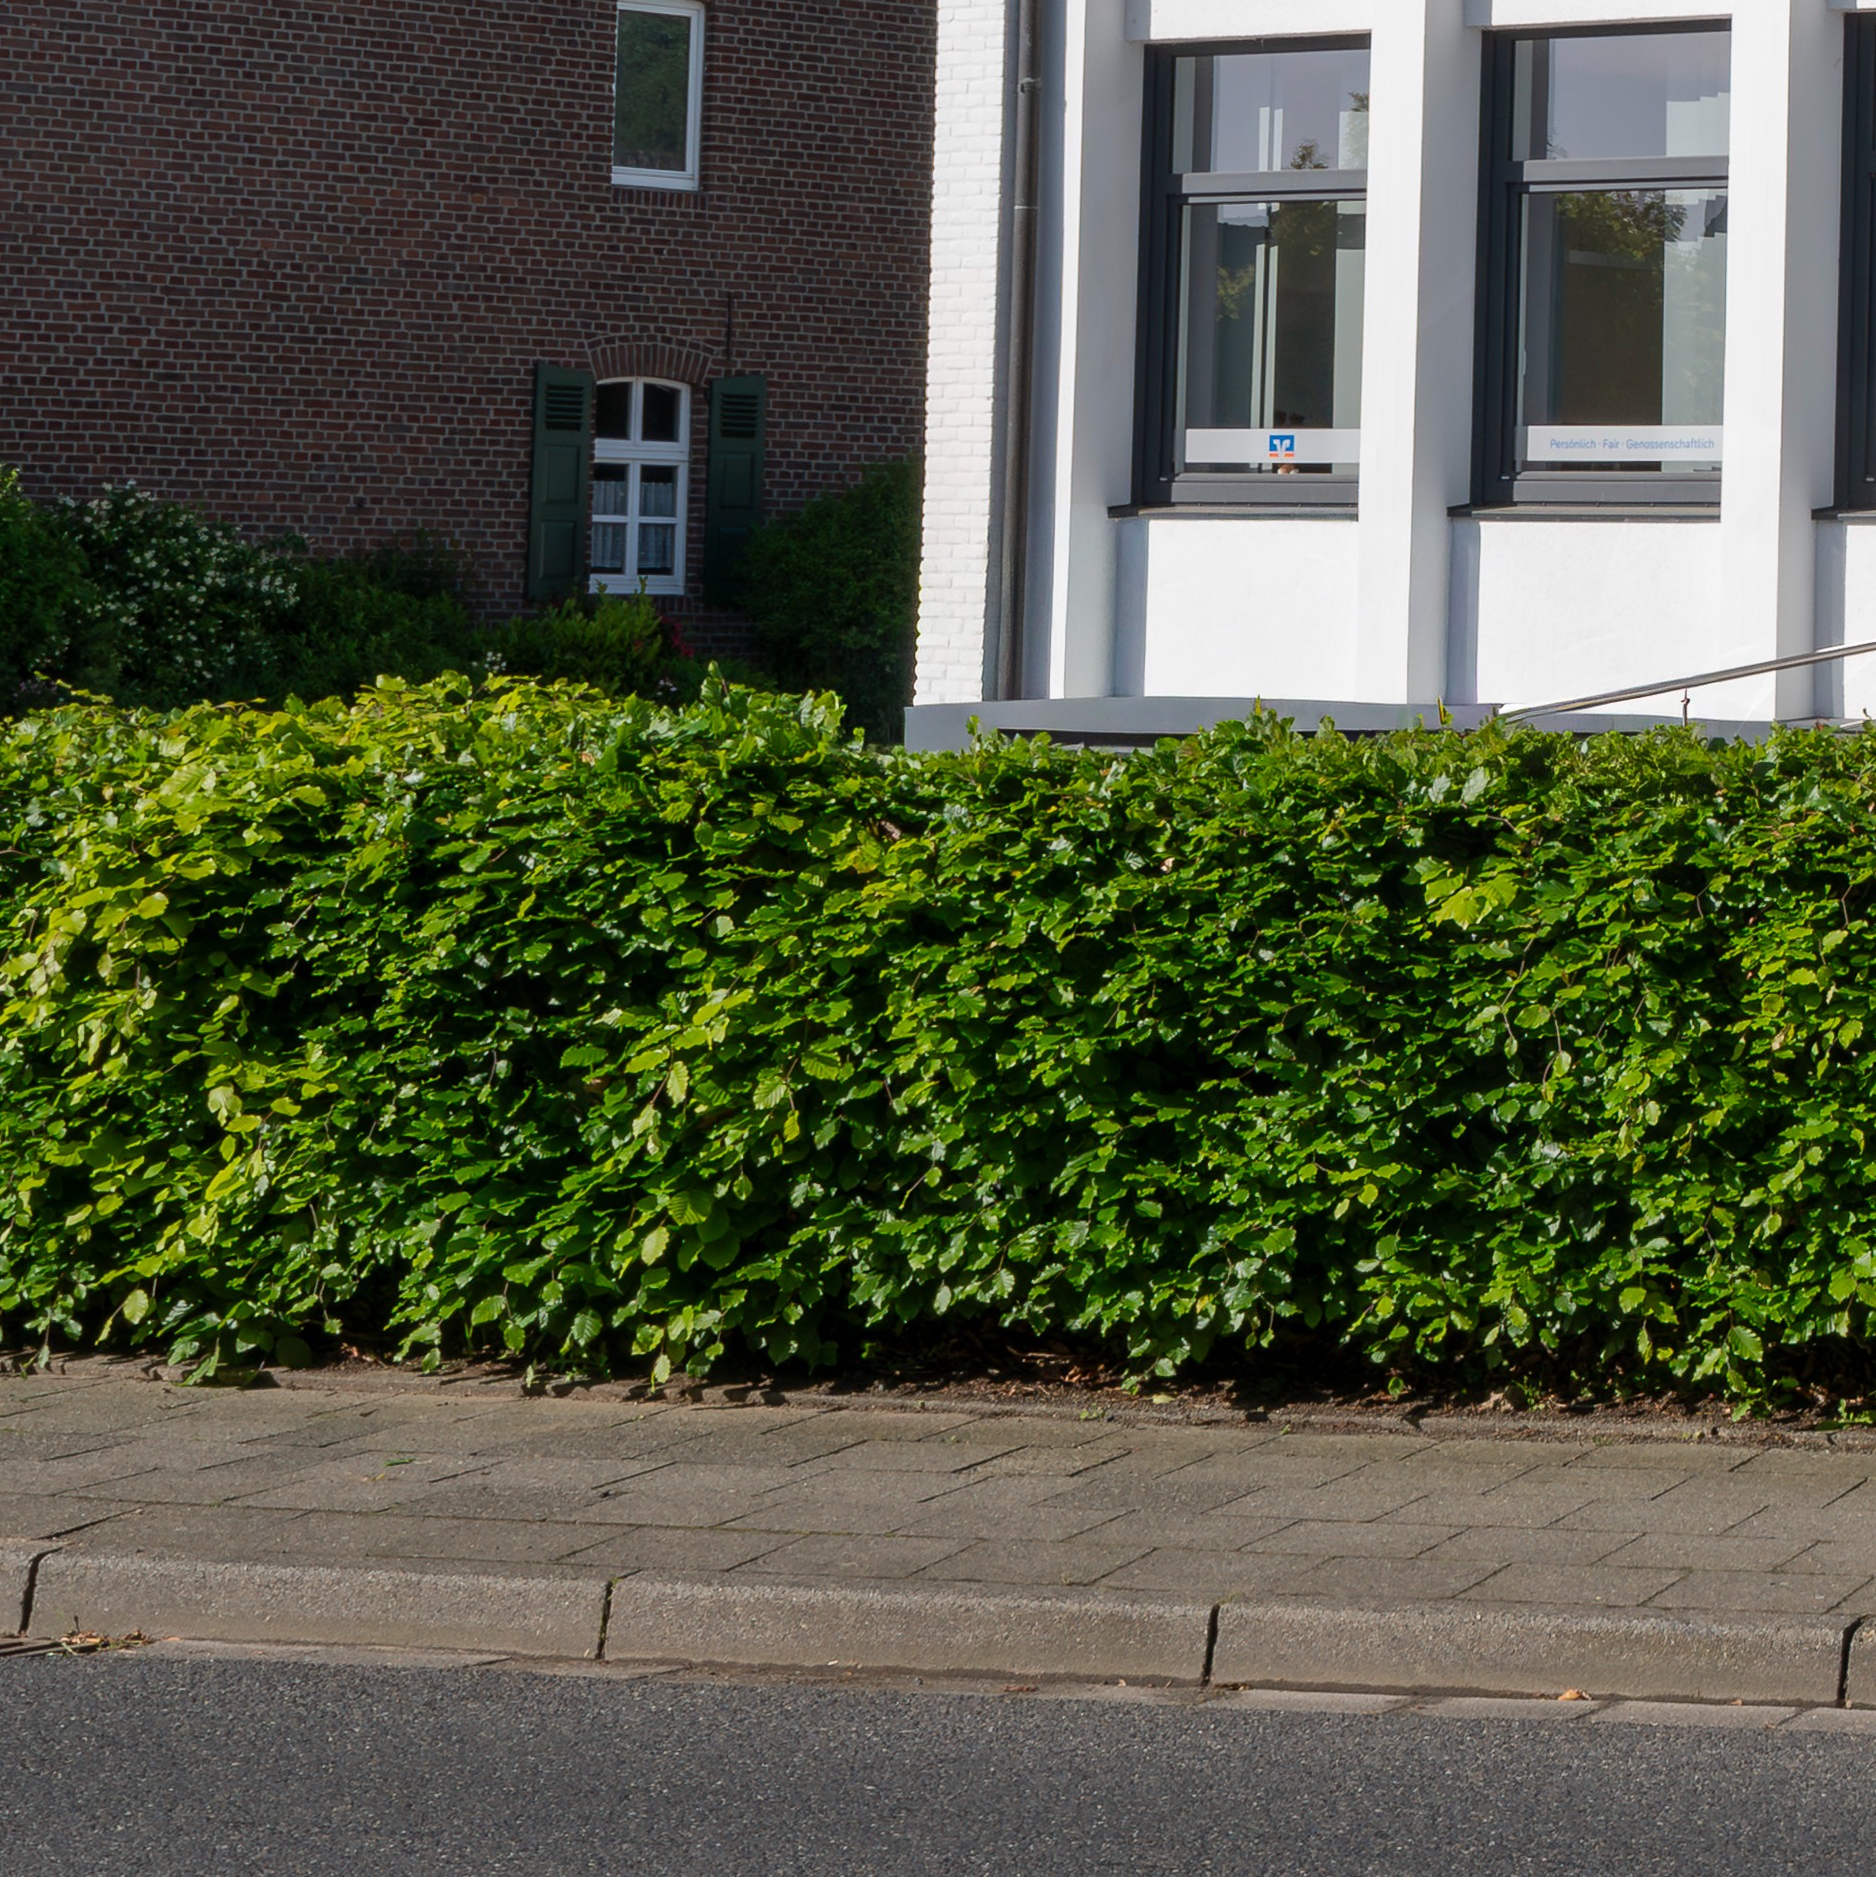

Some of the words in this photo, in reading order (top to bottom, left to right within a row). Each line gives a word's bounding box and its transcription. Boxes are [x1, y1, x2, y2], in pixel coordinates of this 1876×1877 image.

[1549, 438, 1596, 449] Persönlich
[1602, 438, 1620, 449] Fair
[1626, 437, 1715, 449] Genossenschaftlich
